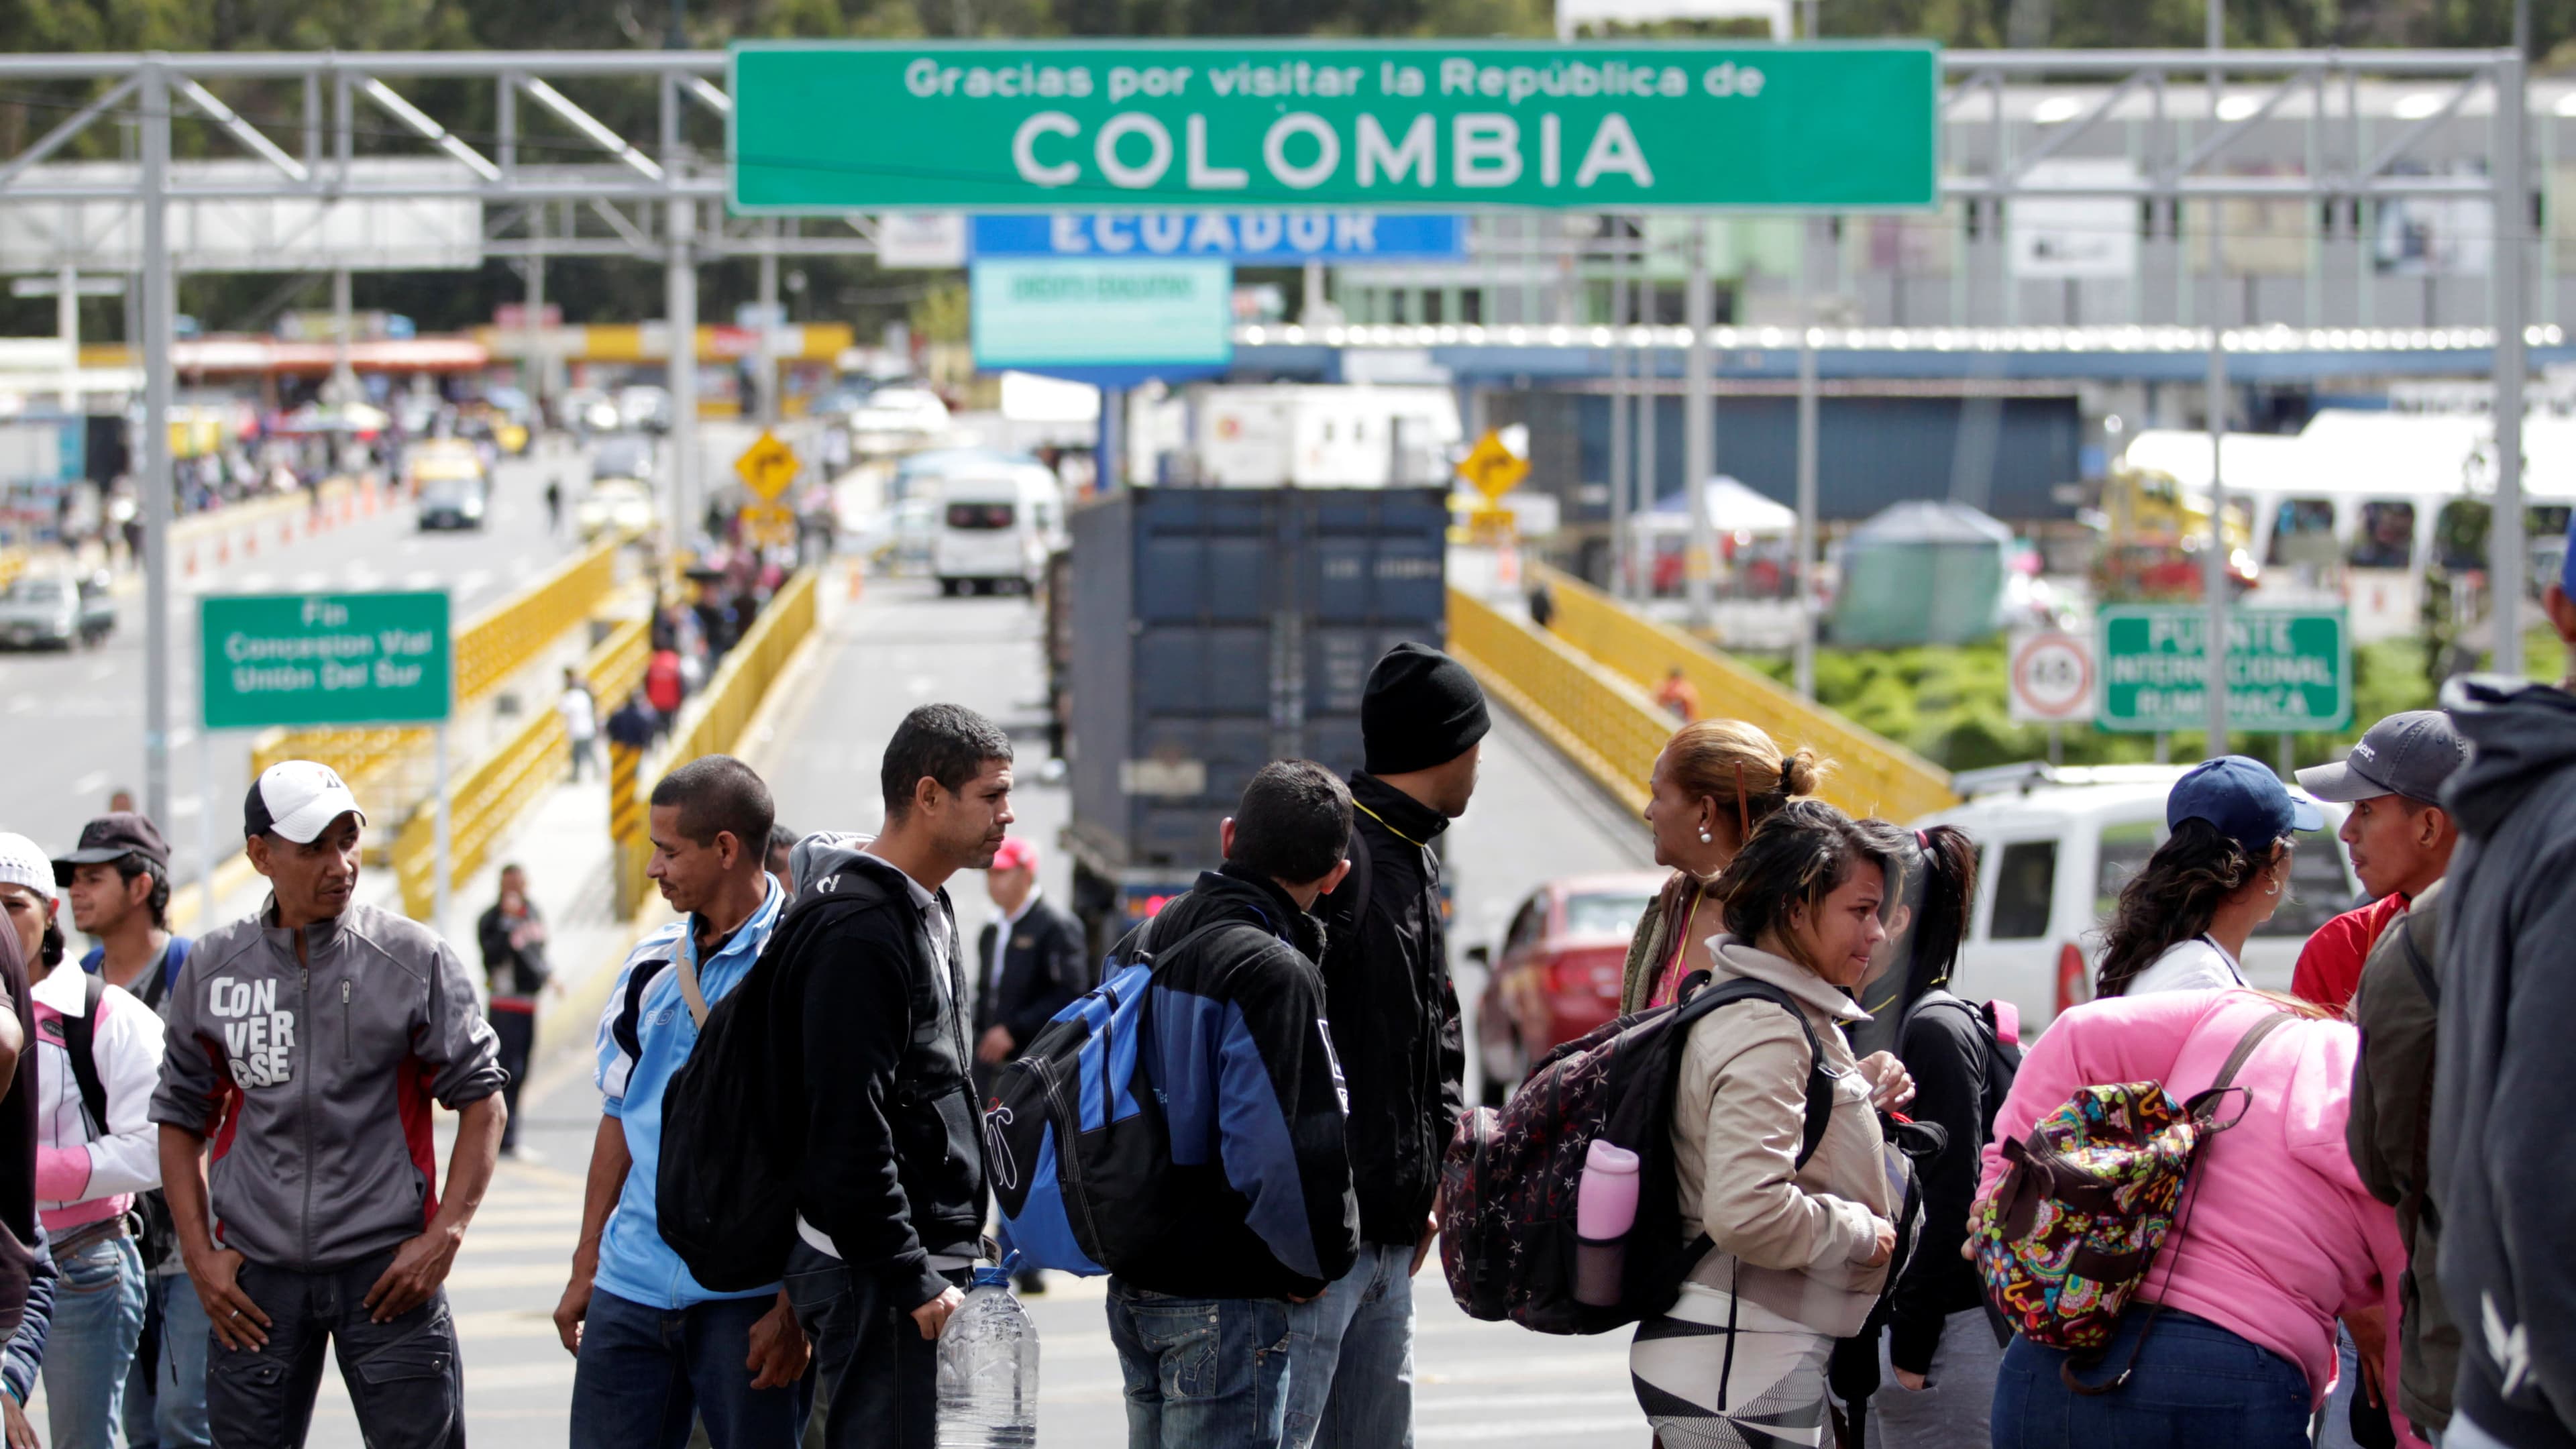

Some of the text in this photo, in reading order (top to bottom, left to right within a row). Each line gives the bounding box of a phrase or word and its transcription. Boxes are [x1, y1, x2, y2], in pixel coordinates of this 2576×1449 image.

[904, 58, 1766, 105] Gracias por visitar la República de
[1011, 111, 1654, 190] COLOMBIA
[1050, 212, 1377, 253] ECUADOR
[301, 596, 348, 627] Fin
[378, 629, 433, 656] Vial
[2149, 614, 2292, 651] PUNTE
[321, 661, 368, 692] Del
[374, 658, 421, 688] Sur
[2108, 653, 2334, 686] INTERNCIONAL
[2135, 688, 2308, 717] RUMIHACA
[225, 1010, 295, 1058] VER
